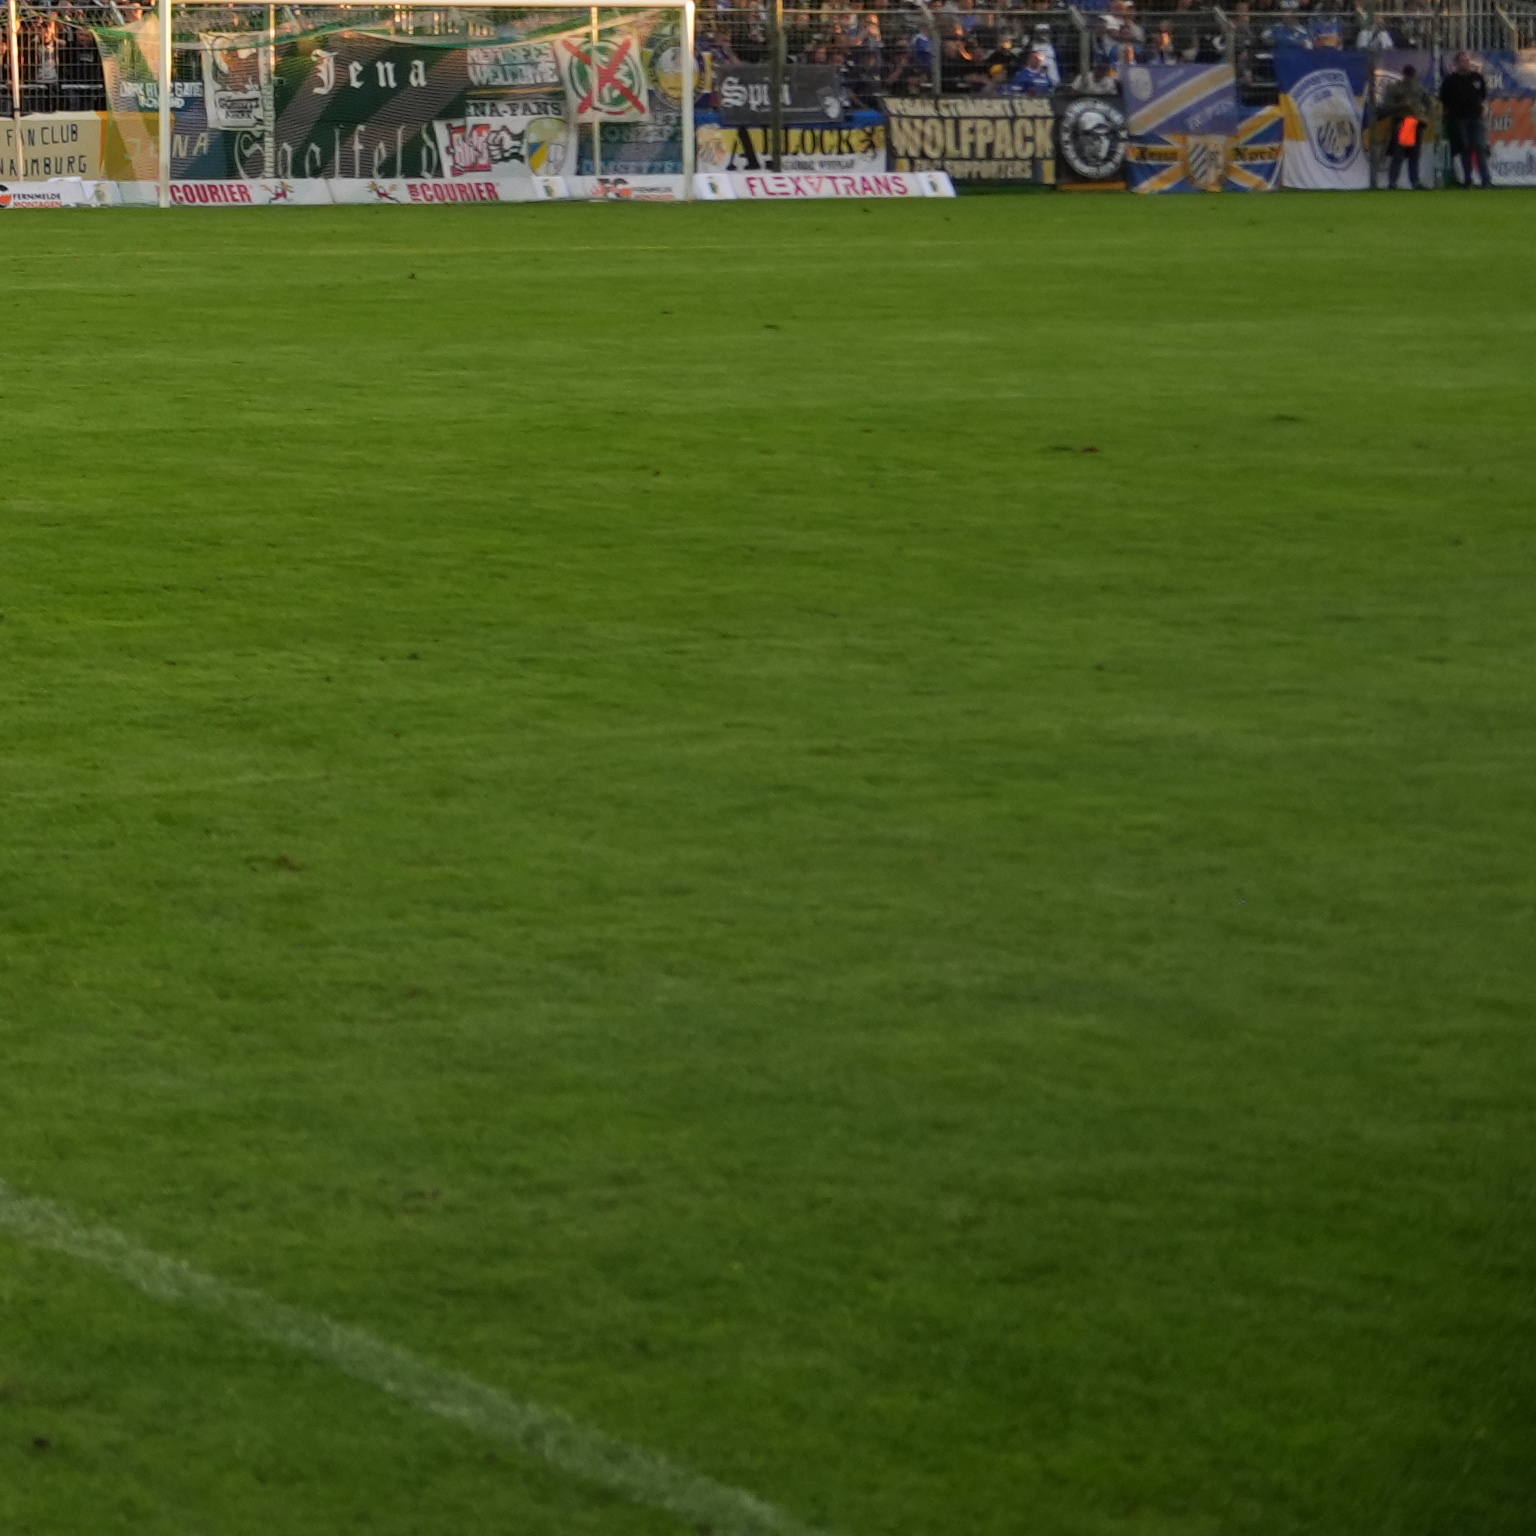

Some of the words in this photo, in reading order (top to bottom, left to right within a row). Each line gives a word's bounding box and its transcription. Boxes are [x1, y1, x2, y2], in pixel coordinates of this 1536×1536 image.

[41, 123, 79, 146] CLUB
[890, 118, 1056, 160] WOLFPACK
[170, 183, 253, 204] COURIER
[421, 181, 499, 203] COURIER
